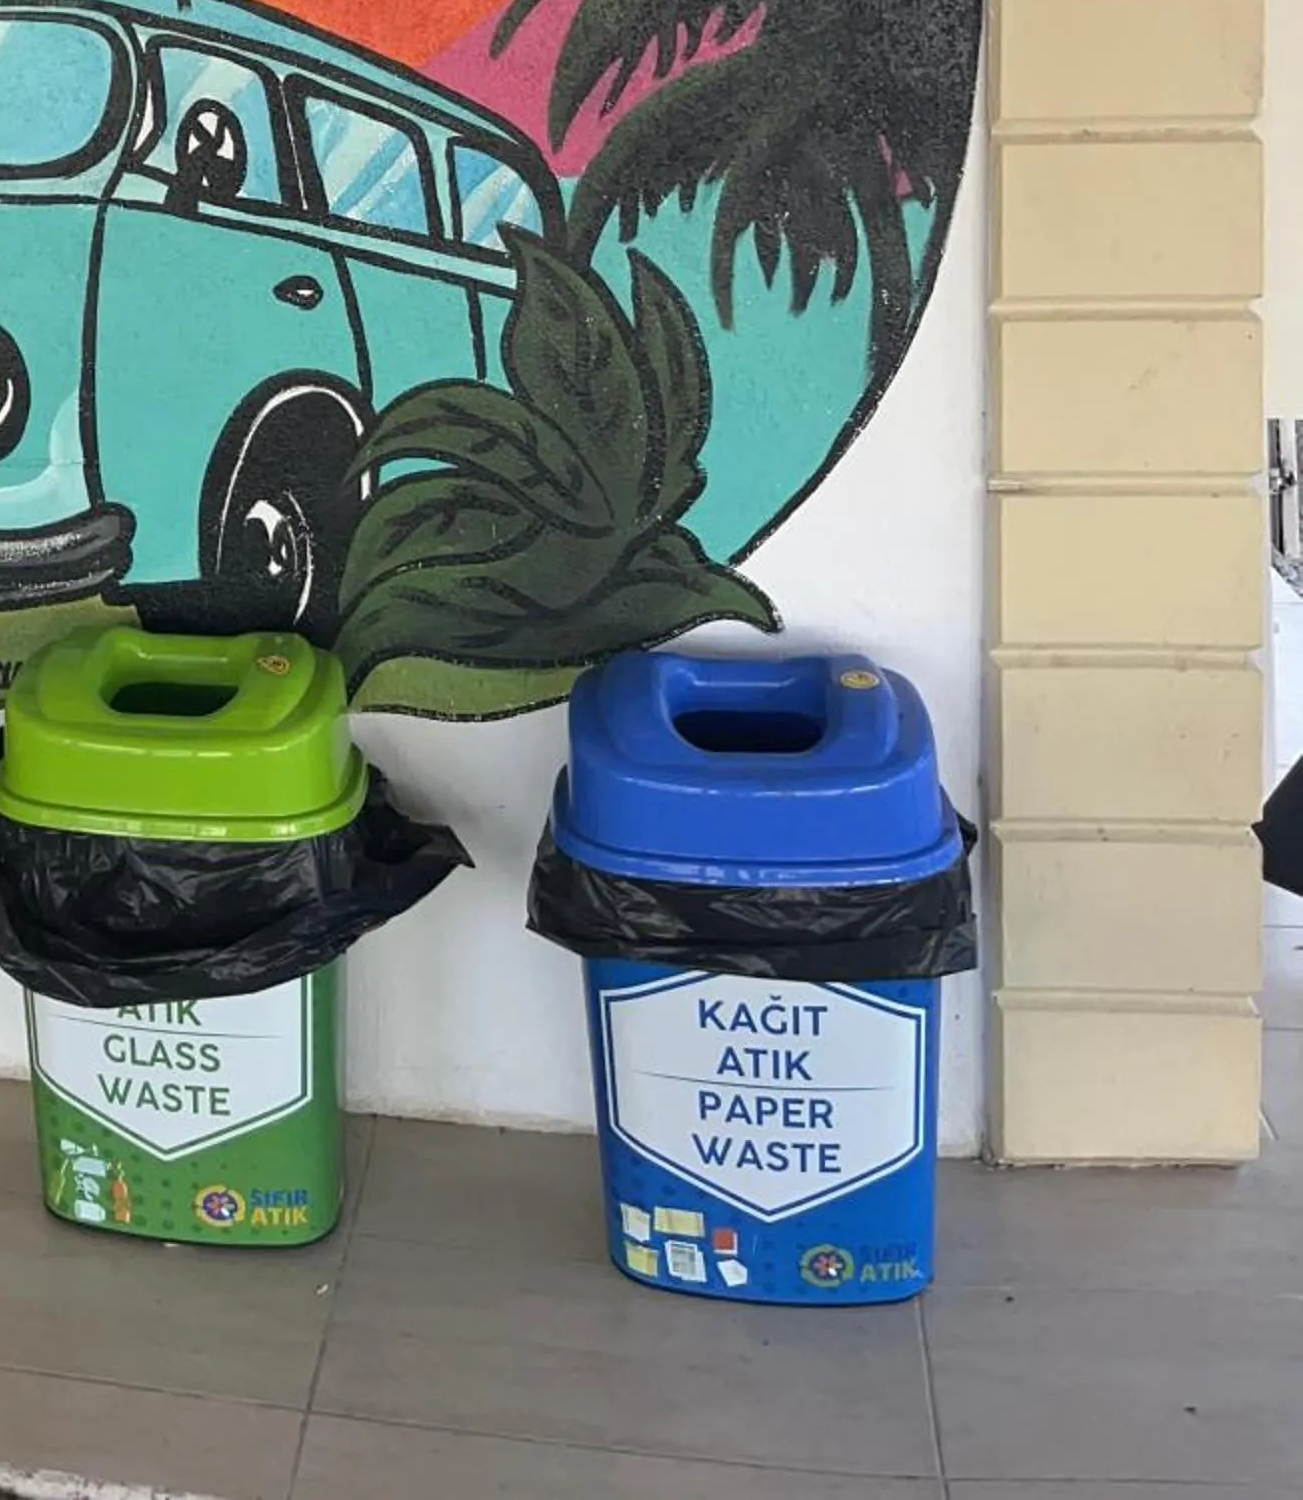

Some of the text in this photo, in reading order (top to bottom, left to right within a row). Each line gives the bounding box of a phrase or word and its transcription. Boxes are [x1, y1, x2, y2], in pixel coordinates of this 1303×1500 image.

[698, 994, 828, 1037] KAĞIT
[103, 1033, 222, 1073] GLASS
[716, 1046, 813, 1081] ATIK
[97, 1073, 232, 1117] WASTE
[698, 1090, 834, 1129] PAPER
[692, 1133, 842, 1173] WASTE
[250, 1188, 309, 1206] SIFIR
[250, 1206, 309, 1227] ATIK
[859, 1259, 921, 1284] ATIK
